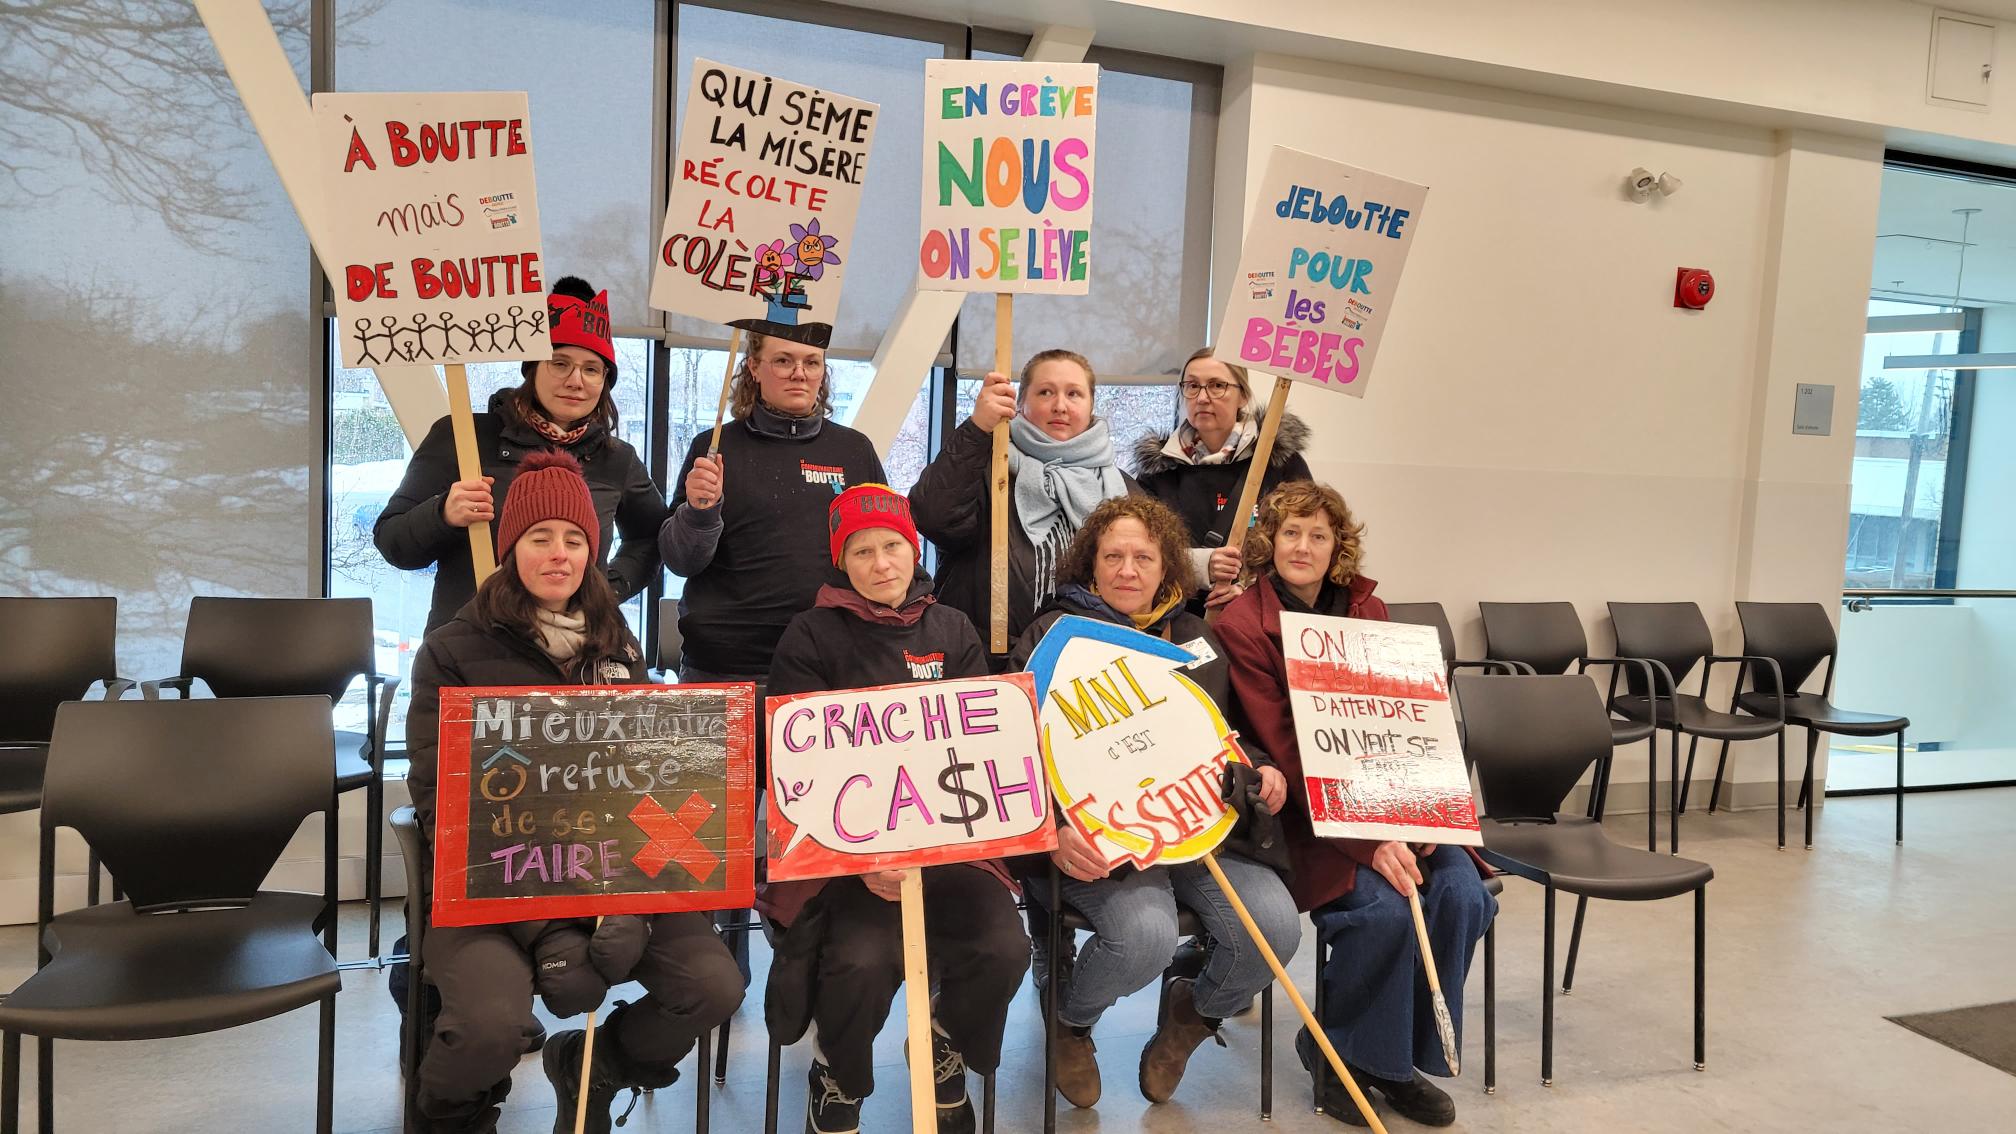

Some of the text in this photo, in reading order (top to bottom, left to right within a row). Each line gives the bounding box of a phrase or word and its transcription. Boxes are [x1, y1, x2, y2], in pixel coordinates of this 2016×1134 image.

[941, 76, 1094, 119] EN GRÈVE
[344, 114, 527, 172] À BOUTTE
[710, 116, 746, 151] LA
[683, 158, 828, 211] RÉCOLTE
[938, 137, 1089, 214] NOUS
[377, 193, 464, 236] mais
[697, 199, 734, 232] LA
[663, 234, 813, 310] COLÈRE
[920, 219, 1088, 282] ON SE LÈVE
[1288, 247, 1373, 295] POUR
[345, 252, 542, 302] DE BOUTTE
[1285, 289, 1326, 324] les
[1300, 627, 1346, 662] ON
[1049, 656, 1168, 740] MNL
[474, 700, 626, 743] Mieux
[783, 689, 1000, 753] CRACHE
[1314, 728, 1351, 756] ON
[1406, 736, 1442, 759] SE
[539, 751, 681, 795] refuse
[833, 747, 1043, 843] CA$H
[491, 804, 597, 838] de se
[490, 839, 625, 884] TAIRE
